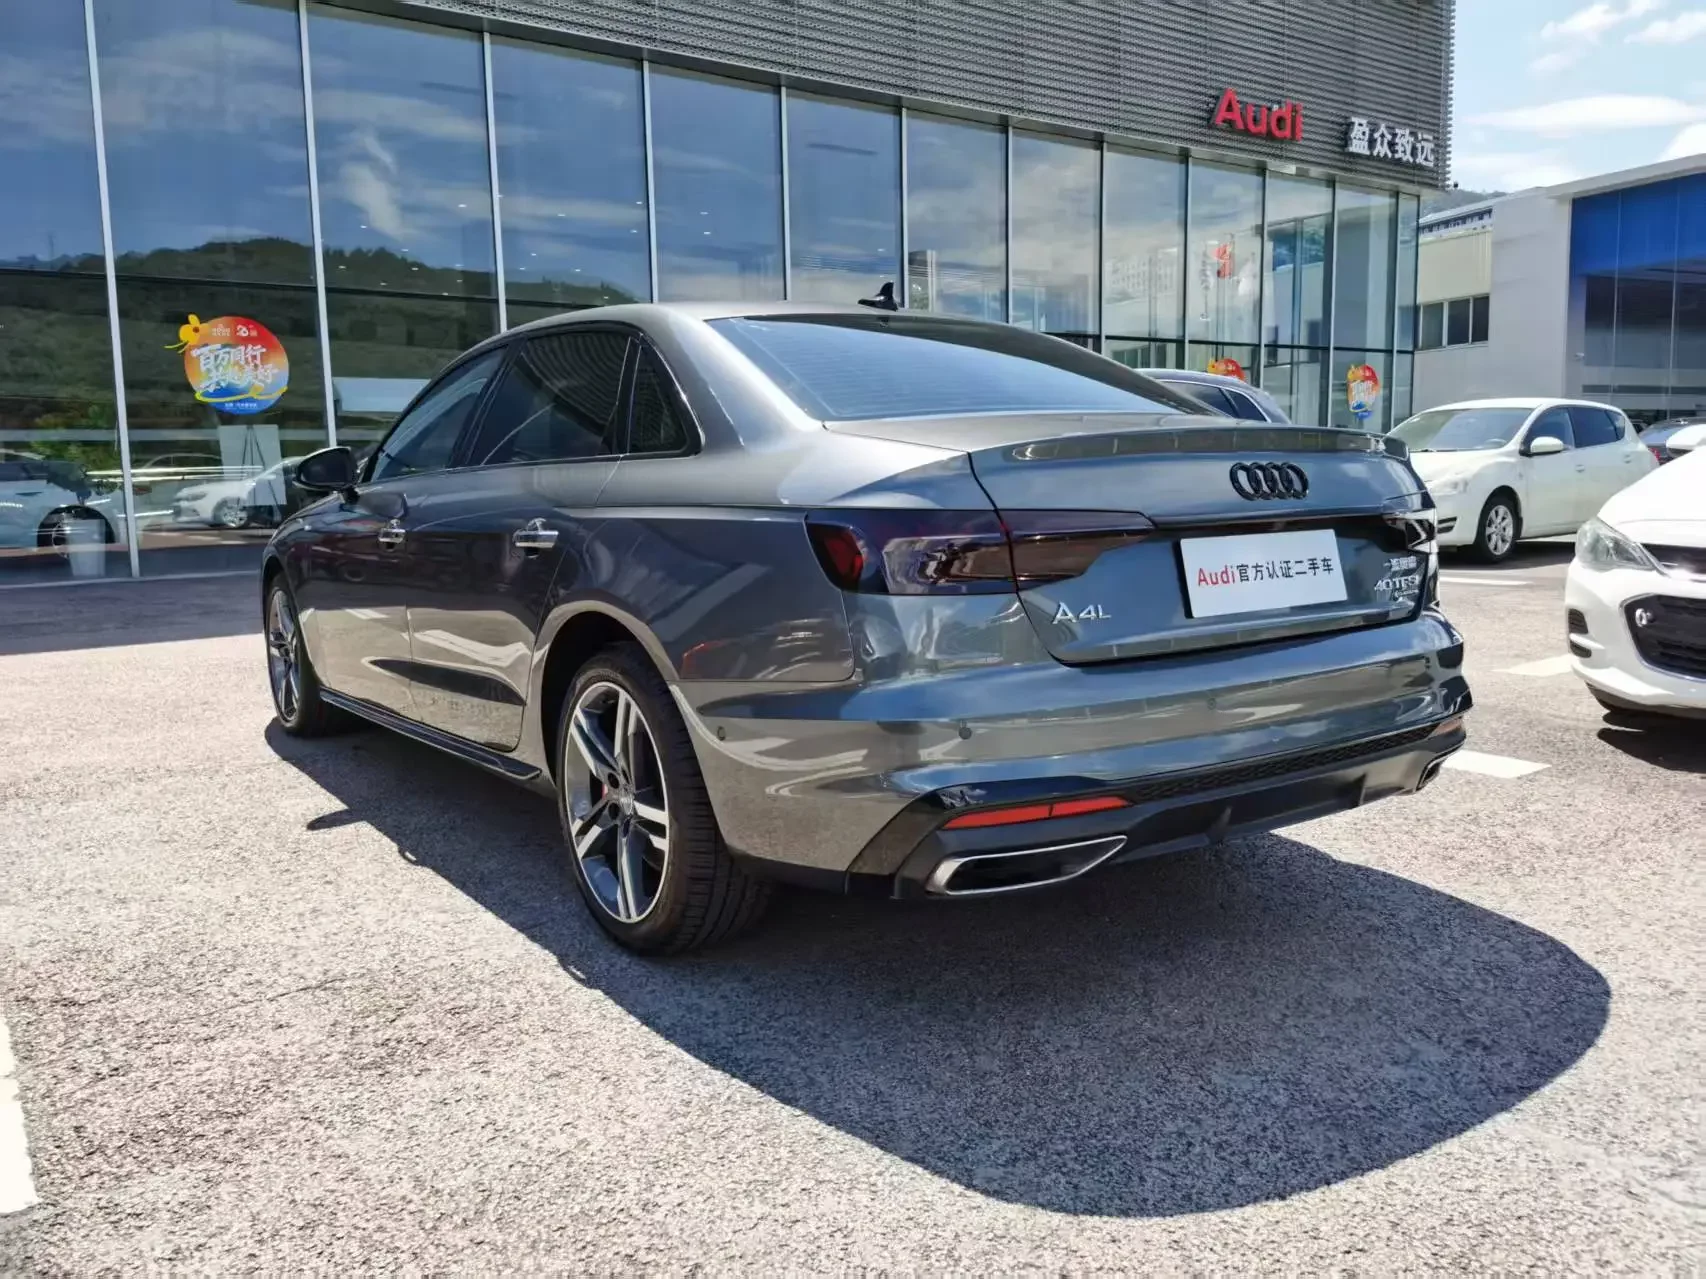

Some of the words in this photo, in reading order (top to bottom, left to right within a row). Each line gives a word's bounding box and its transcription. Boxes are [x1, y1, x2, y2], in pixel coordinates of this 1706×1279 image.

[1213, 87, 1304, 142] Audi
[1349, 116, 1435, 167] 盈众致远
[1052, 601, 1112, 625] A4L
